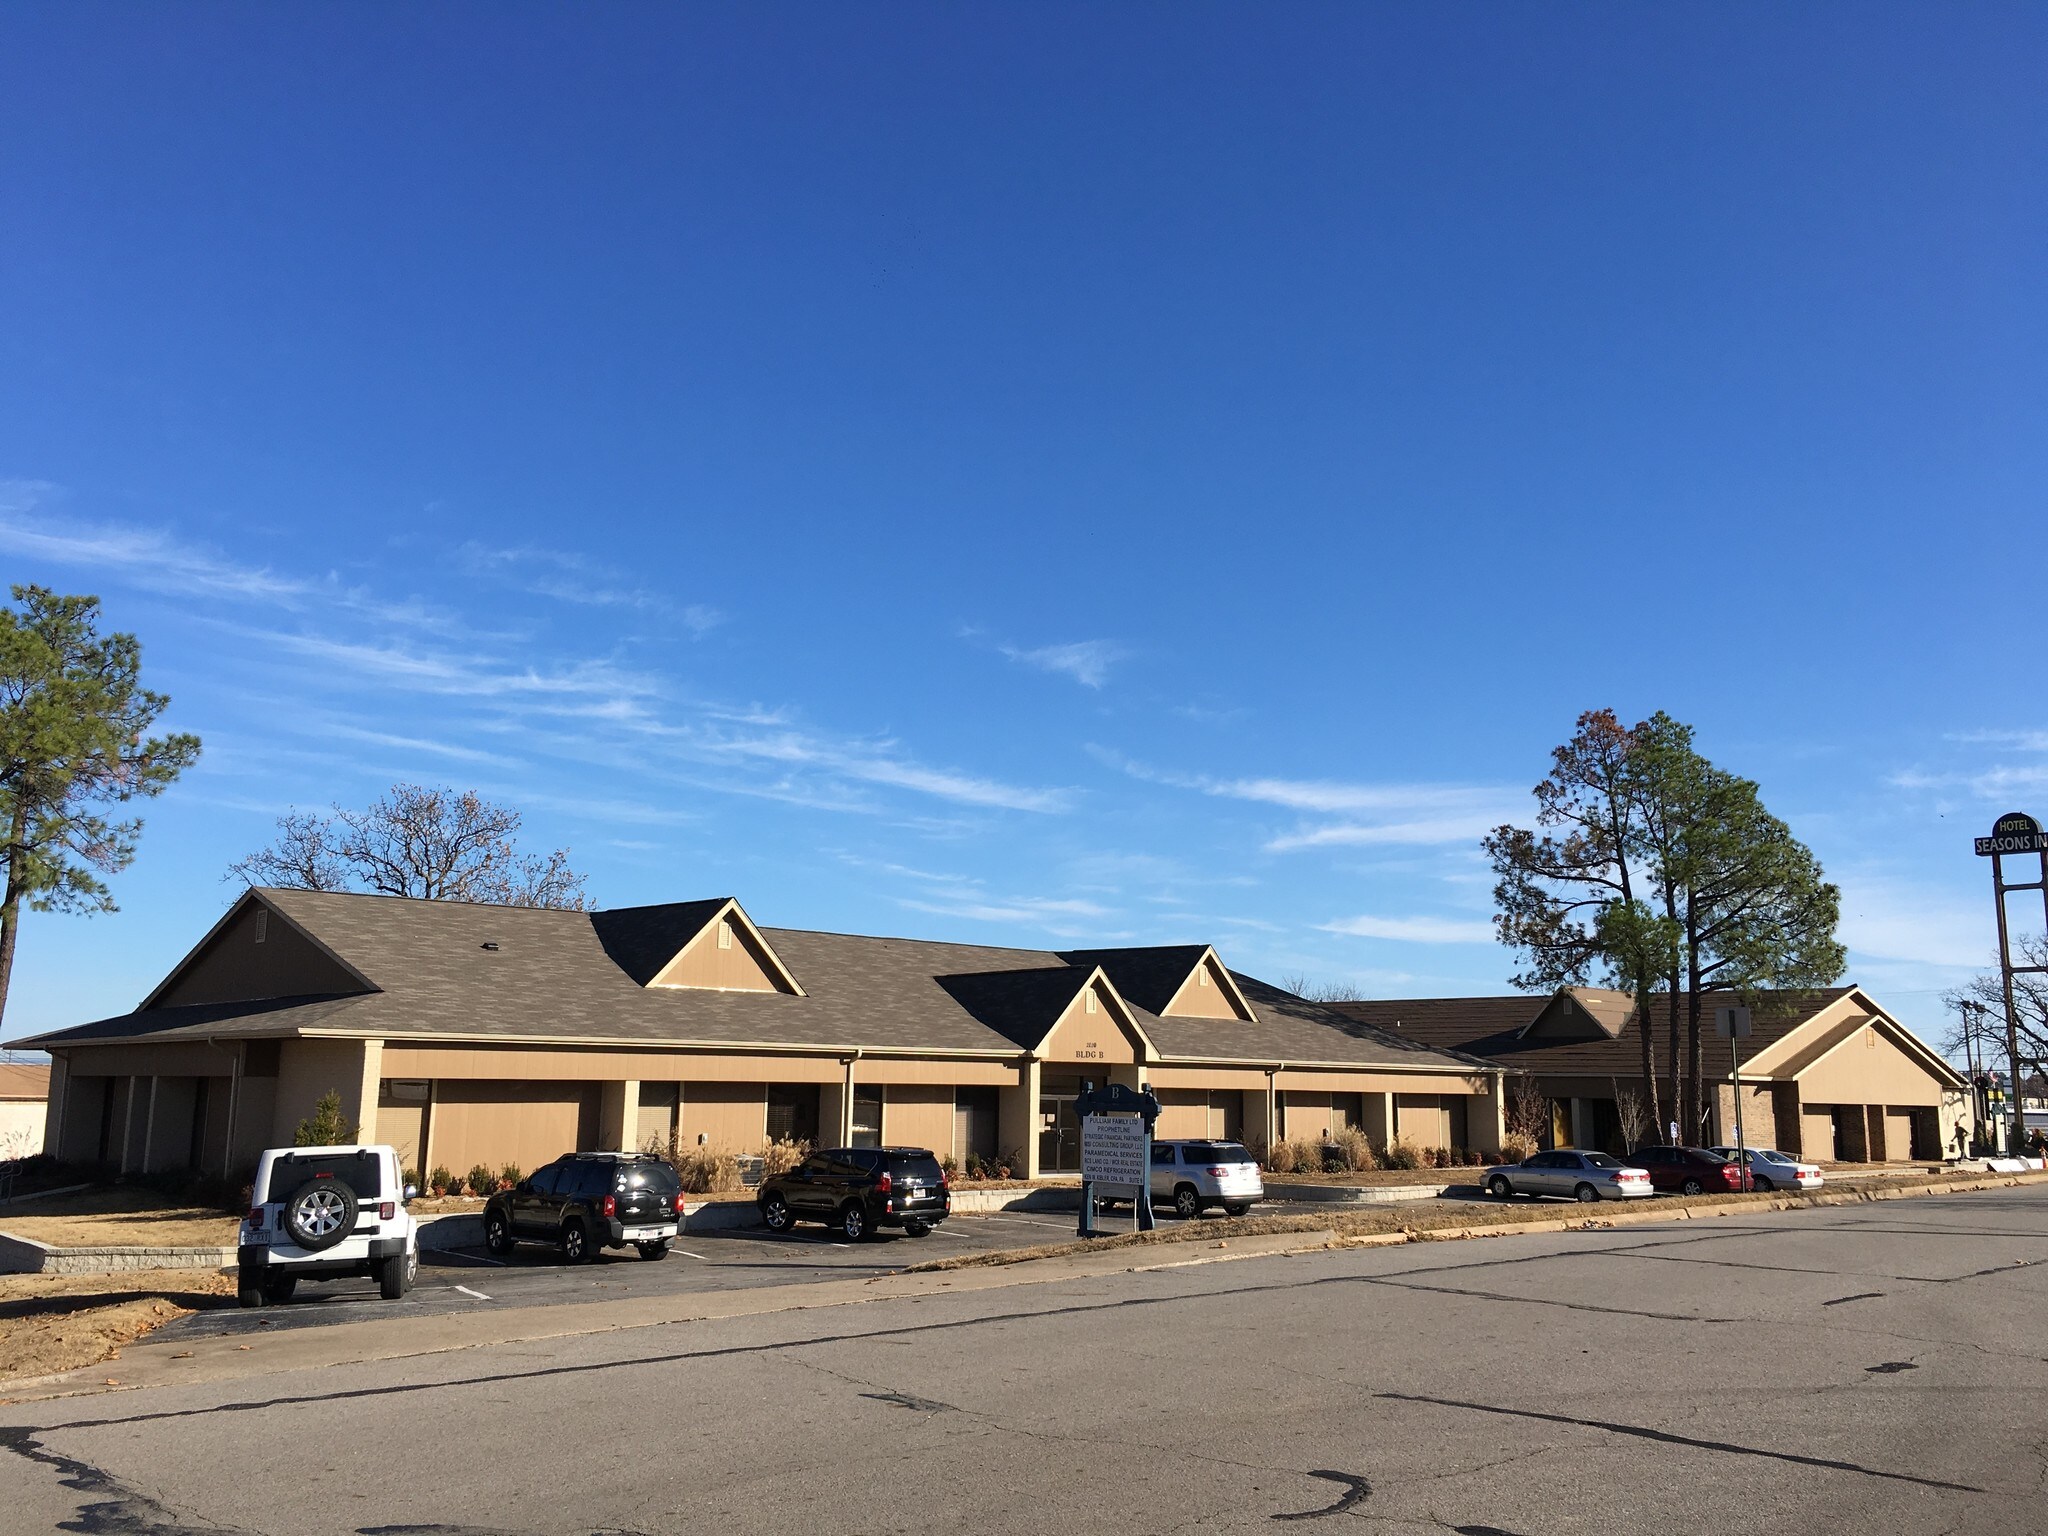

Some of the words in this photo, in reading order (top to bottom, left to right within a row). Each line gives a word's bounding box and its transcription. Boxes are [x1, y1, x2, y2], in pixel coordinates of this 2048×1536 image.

[2000, 820, 2030, 831] HOTEL
[1976, 836, 2031, 853] SEASONS
[1112, 1087, 1119, 1099] B
[1092, 1141, 1119, 1149] CONSULTING
[1084, 1149, 1119, 1157] PARAMEDICAL
[1120, 1151, 1143, 1159] SERVICES
[1130, 1160, 1143, 1168] ESTATE
[1104, 1167, 1140, 1175] REFRIGERATION
